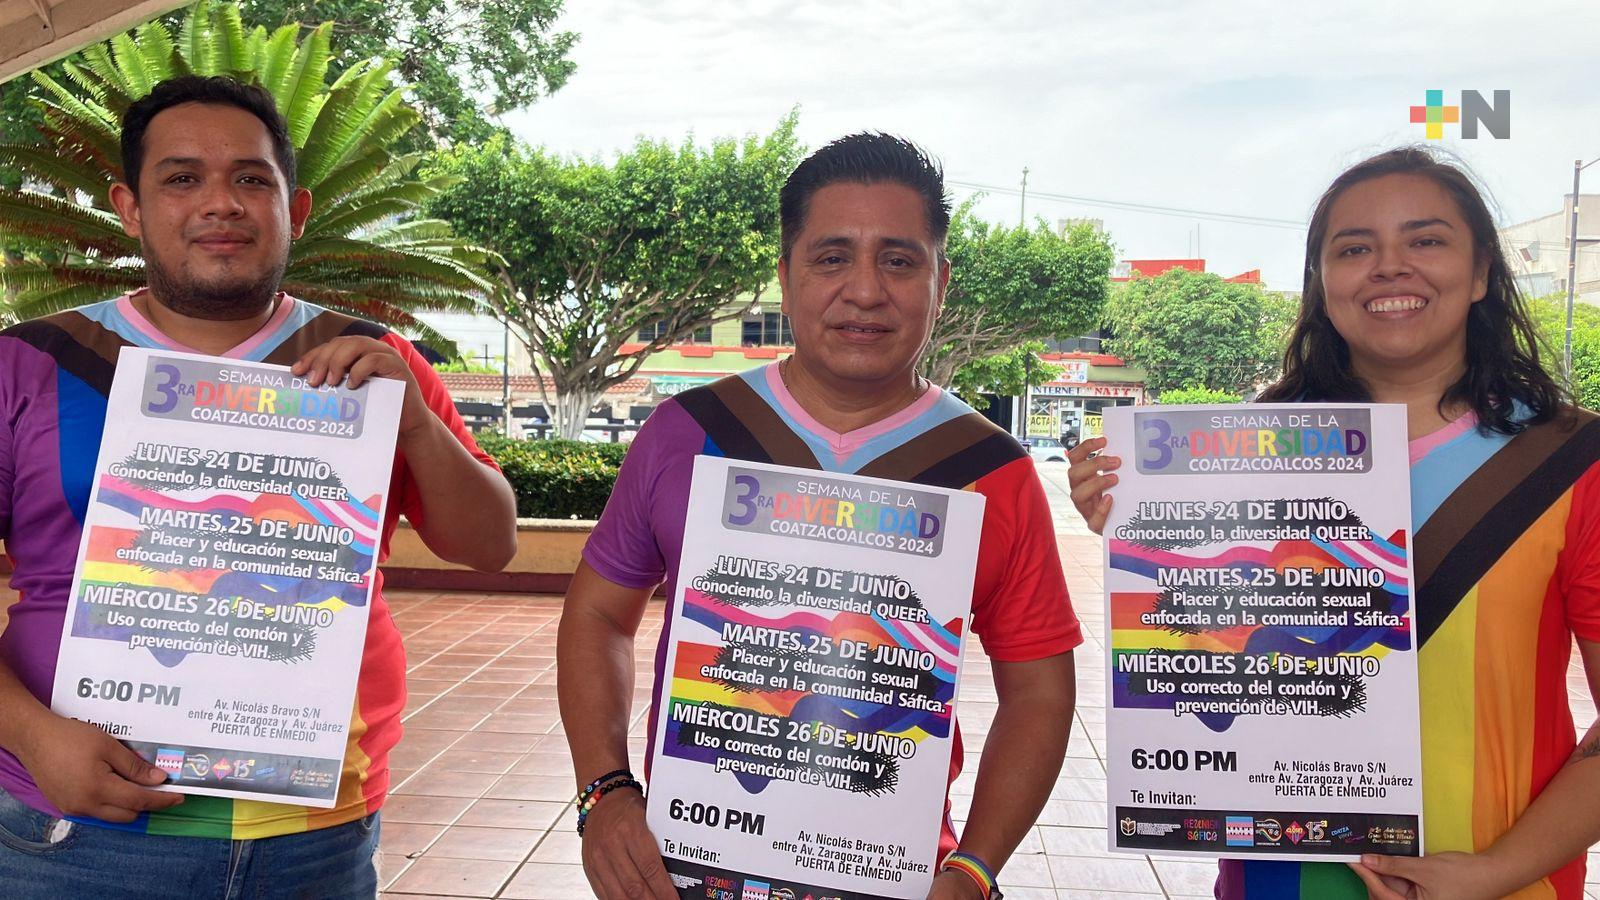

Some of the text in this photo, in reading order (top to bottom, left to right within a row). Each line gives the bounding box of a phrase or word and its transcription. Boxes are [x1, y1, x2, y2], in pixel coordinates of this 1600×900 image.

[219, 369, 286, 389] SEMANA
[196, 381, 360, 422] DIVERSIDAD
[191, 407, 354, 437] COATZACOALCOS 2024
[1084, 416, 1103, 427] ACT
[1211, 415, 1339, 428] SEMANA DE LA
[1190, 429, 1366, 456] DIVERSIDAD
[135, 442, 331, 481] LUNES 24 DE JUNIO
[1189, 457, 1364, 471] COATZACOALCOS 2024
[797, 481, 917, 508] SEMANA DE LA
[775, 492, 940, 539] DIVERSIDAD
[1139, 502, 1347, 520] LUNES 24 DE JUNIO
[227, 515, 254, 535] 25
[259, 519, 288, 538] DE
[293, 522, 354, 546] JUNIO
[769, 520, 933, 554] COATZACOALCOS 2024
[1116, 527, 1372, 541] Conociendo la diversidad QUEER.
[716, 555, 910, 600] LUNES 24 DE JUNIO
[1251, 568, 1276, 586] 25
[1284, 568, 1313, 586] DE
[1321, 568, 1385, 587] JUNIO
[83, 582, 333, 628] MIÉRCOLES 26 DE JUNIO
[691, 577, 930, 624] Conociendo la diversidad QUEER.
[1173, 592, 1371, 609] Placer y educación sexual
[1141, 611, 1403, 627] enfocada en la comunidad Sáfica.
[807, 635, 833, 656] 25
[839, 639, 868, 661] DE
[873, 644, 935, 672] JUNIO
[1118, 650, 1379, 677] MIÉRCOLES 26 DE JUNIO
[732, 648, 918, 690] Placer y educación sexual
[76, 677, 181, 706] 6:00 PM
[700, 662, 946, 714] enfocada en la comunidad Sáfica.
[1146, 679, 1351, 699] Uso correcto del condón y
[214, 699, 321, 719] Av. Nicolás Bravo S/N
[1175, 699, 1322, 716] prevención de VIH.
[212, 723, 316, 743] PUERTA DE ENMEDIO
[672, 701, 916, 760] MIÉRCOLES 26 DE JUNIO
[693, 730, 885, 779] Uso correcto del condón y
[1131, 749, 1237, 771] 6:00 PM
[1274, 761, 1386, 773] Av. Nicolás Bravo S/N
[716, 754, 854, 791] prevención de VIH.
[1249, 774, 1413, 786] entre Av. Zaragoza y Av. Juárez
[1130, 790, 1196, 805] Te Invitan:
[1275, 786, 1386, 798] PUERTA DE ENMEDIO
[669, 798, 766, 836] 6:00 PM
[664, 838, 721, 863] Te Invitan:
[798, 830, 906, 859] Av. Nicolás Bravo S/N
[772, 840, 929, 877] entre Av. Zaragoza y Av. Juárez
[796, 855, 902, 885] PUERTA DE ENMEDIO
